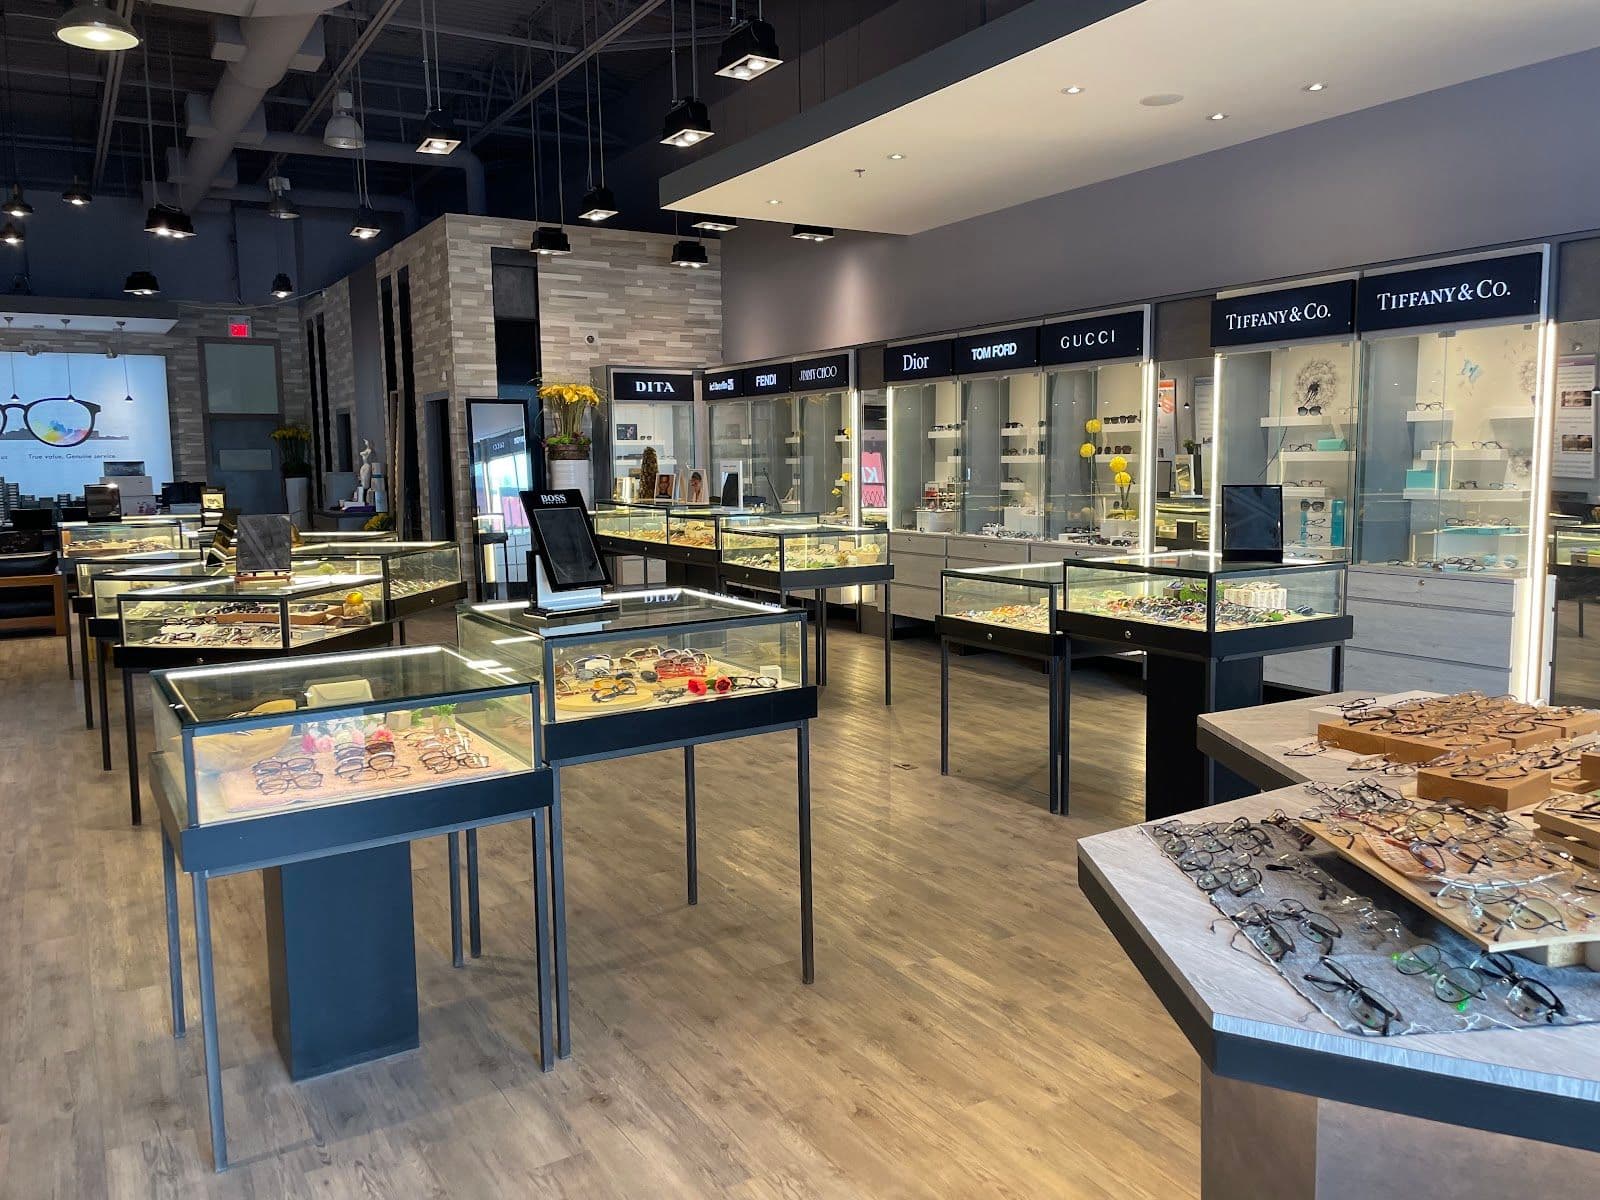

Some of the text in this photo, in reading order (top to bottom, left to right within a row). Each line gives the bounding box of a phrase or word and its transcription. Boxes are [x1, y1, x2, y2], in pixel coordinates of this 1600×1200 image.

[1376, 286, 1457, 311] TIFFANY
[1225, 309, 1289, 330] TIFFANY
[1060, 329, 1115, 349] GUCCI
[971, 342, 1018, 361] TOM FORD
[902, 352, 930, 372] Dior
[755, 373, 777, 387] FENDI
[816, 365, 838, 379] CHOO
[635, 381, 675, 393] DITA
[540, 494, 566, 503] BOSS
